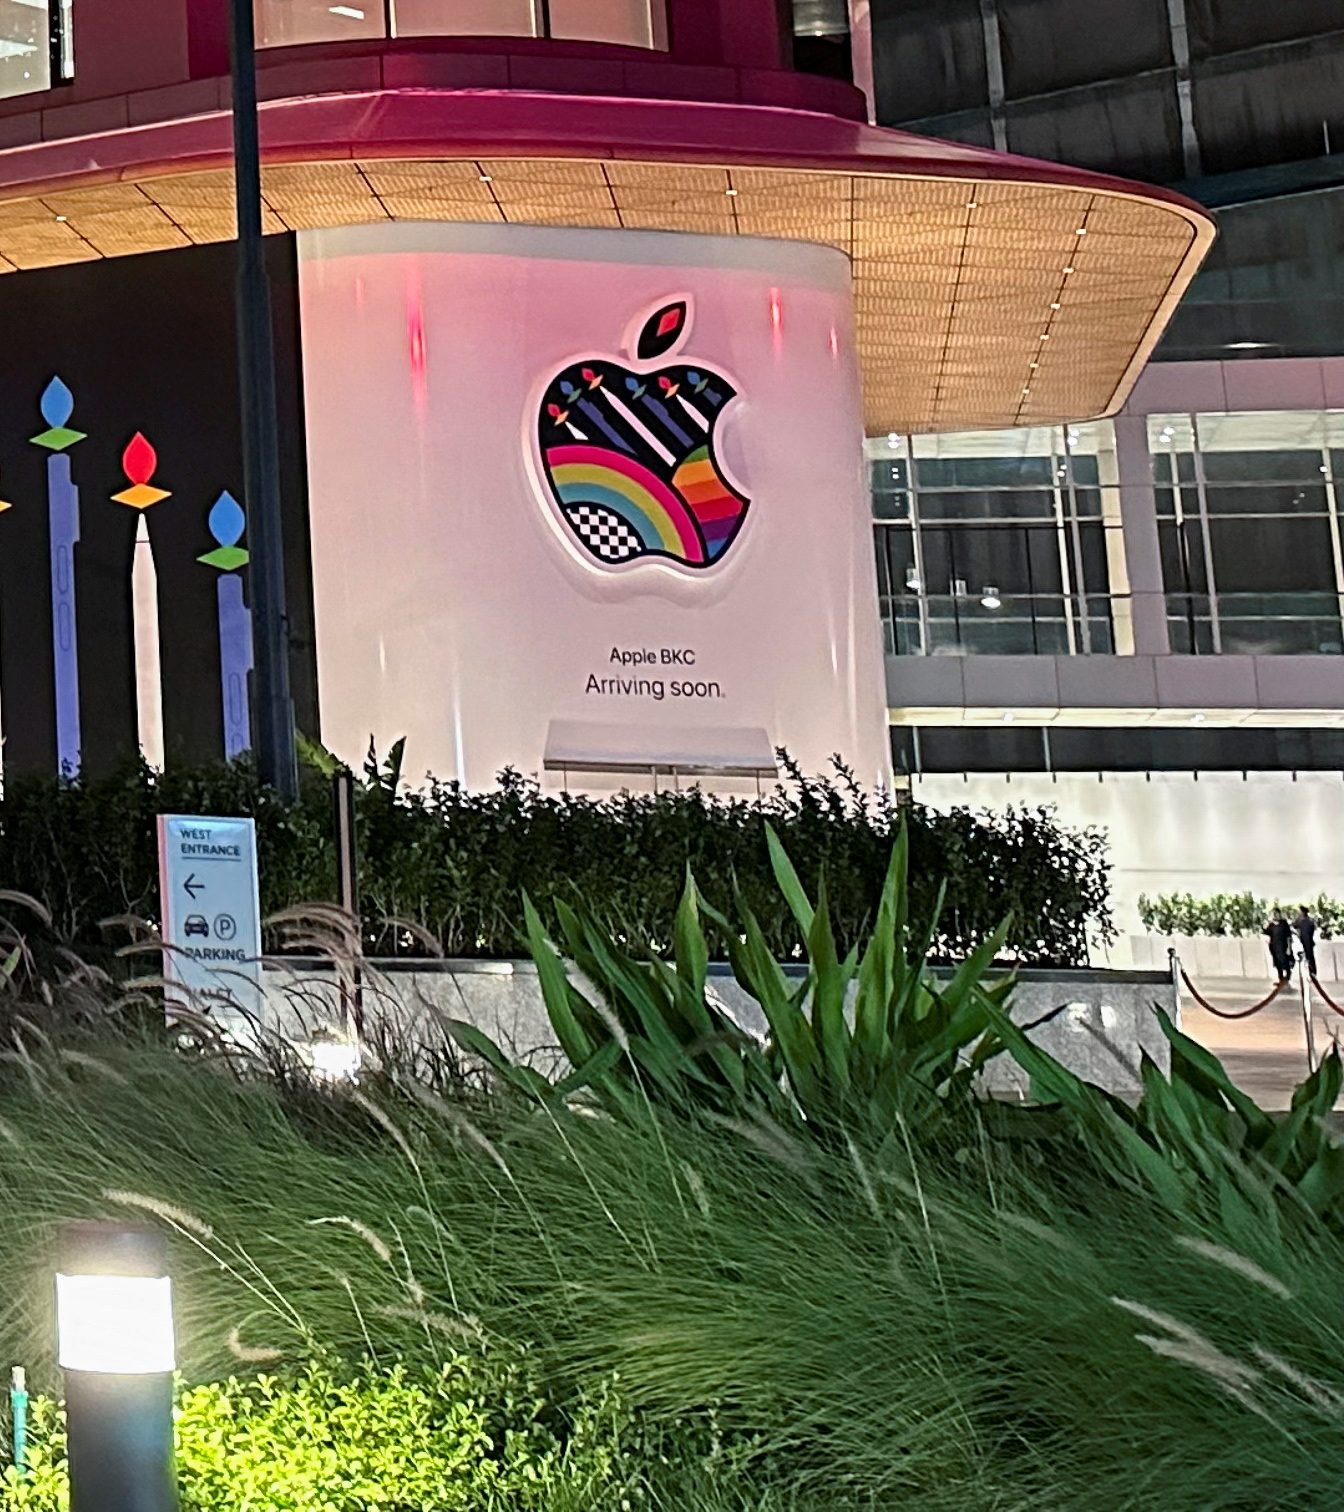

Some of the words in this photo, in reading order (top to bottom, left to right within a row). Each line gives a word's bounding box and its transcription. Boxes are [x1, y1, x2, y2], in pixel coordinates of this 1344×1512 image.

[610, 646, 657, 666] Apple
[660, 648, 696, 666] BKC
[585, 673, 665, 701] Arriving
[670, 680, 726, 698] soon.
[180, 828, 212, 840] WEST
[180, 842, 241, 857] ENTRANCE
